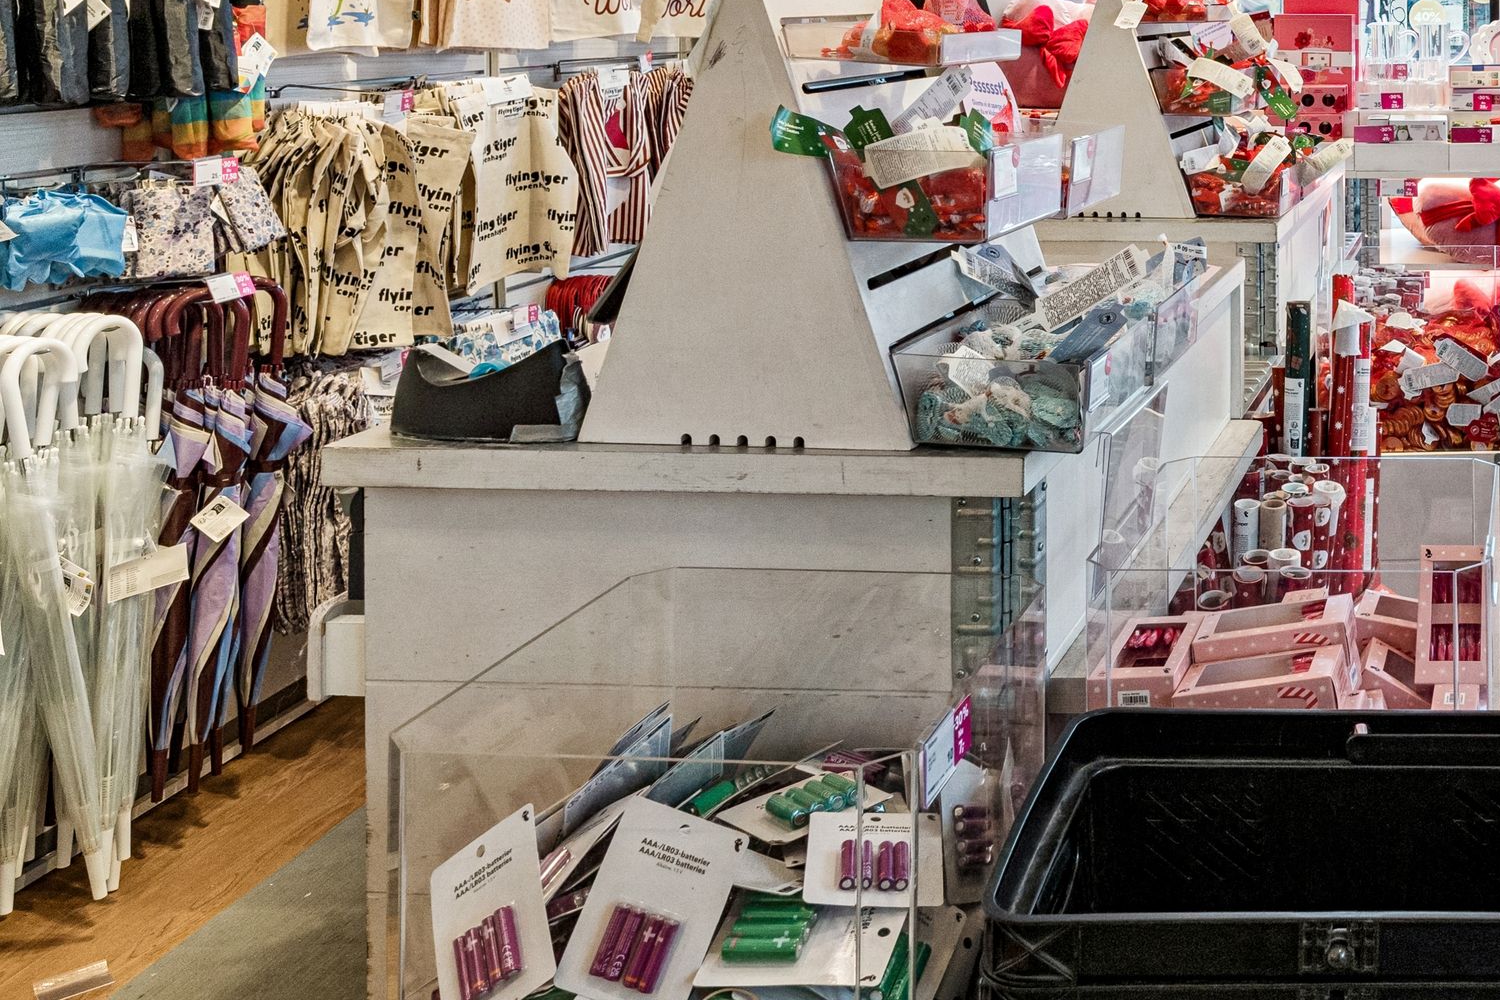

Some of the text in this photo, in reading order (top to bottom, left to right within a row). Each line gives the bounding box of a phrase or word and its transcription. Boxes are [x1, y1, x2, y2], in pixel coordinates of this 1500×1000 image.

[1413, 11, 1441, 23] 40%
[222, 160, 237, 168] -30%
[505, 171, 541, 187] flying
[418, 183, 453, 202] flyin
[547, 208, 576, 225] flyin
[505, 242, 541, 260] flying
[353, 331, 397, 347] tiger
[953, 702, 970, 729] -30%
[638, 846, 707, 876] AAA/LR03 batteries
[640, 836, 712, 868] AAA-/LR03-batterier
[486, 856, 514, 879] batteries
